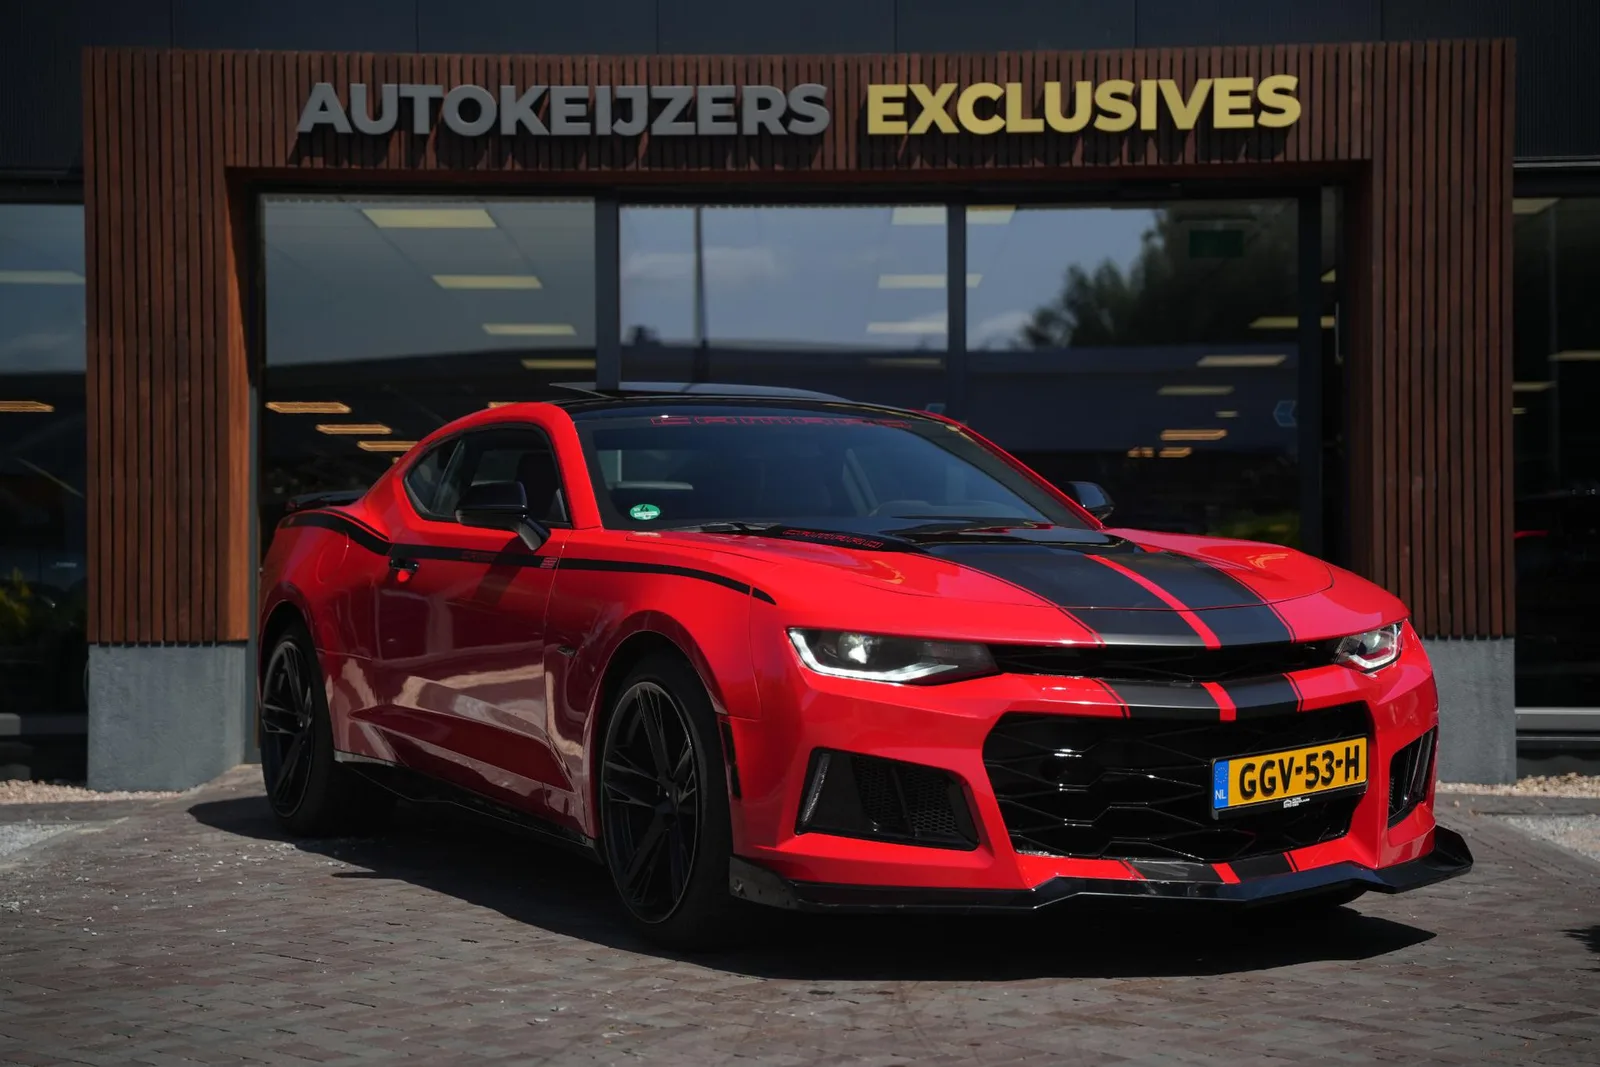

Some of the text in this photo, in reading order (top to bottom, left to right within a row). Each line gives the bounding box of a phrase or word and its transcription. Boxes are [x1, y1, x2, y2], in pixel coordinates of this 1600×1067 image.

[298, 75, 1302, 136] AUTOKEIJZERS EXCLUSIVES
[1215, 790, 1227, 800] NL
[1239, 745, 1360, 800] GGV-53-H
